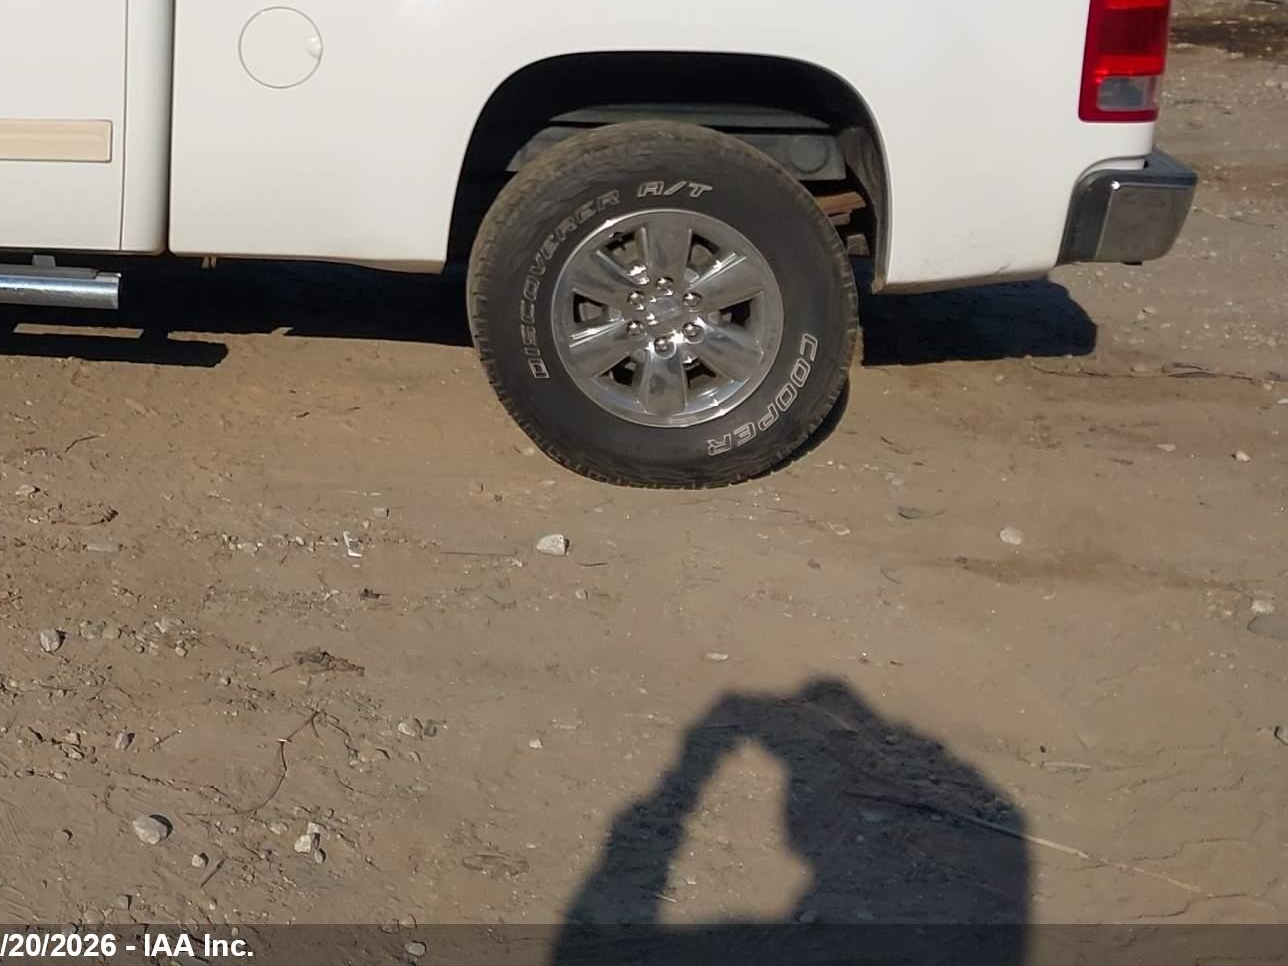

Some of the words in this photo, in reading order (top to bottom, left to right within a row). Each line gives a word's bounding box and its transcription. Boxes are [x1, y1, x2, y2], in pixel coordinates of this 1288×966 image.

[520, 189, 620, 380] DISCOVERER
[636, 180, 714, 199] A/T
[706, 333, 820, 458] COOPER
